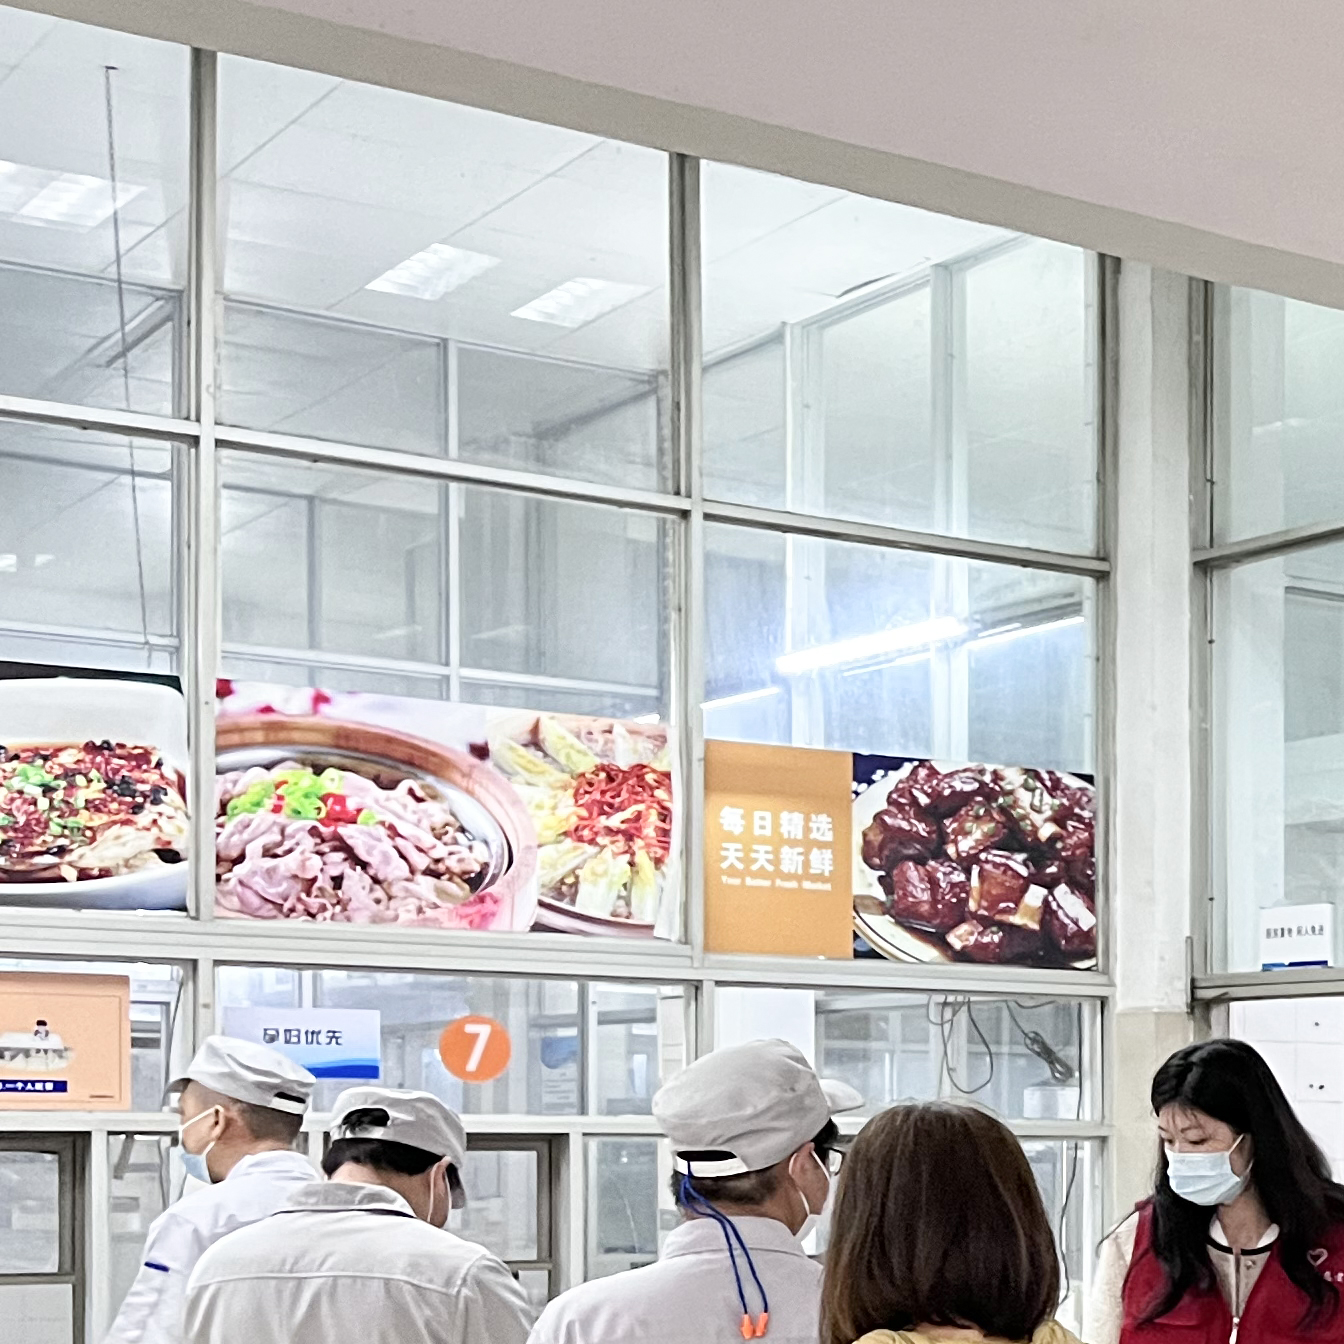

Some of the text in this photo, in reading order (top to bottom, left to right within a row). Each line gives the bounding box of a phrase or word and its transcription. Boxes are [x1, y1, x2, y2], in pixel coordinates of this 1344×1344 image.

[719, 805, 833, 842] 每日精选
[719, 842, 833, 876] 天天新鲜
[464, 1023, 492, 1072] 7
